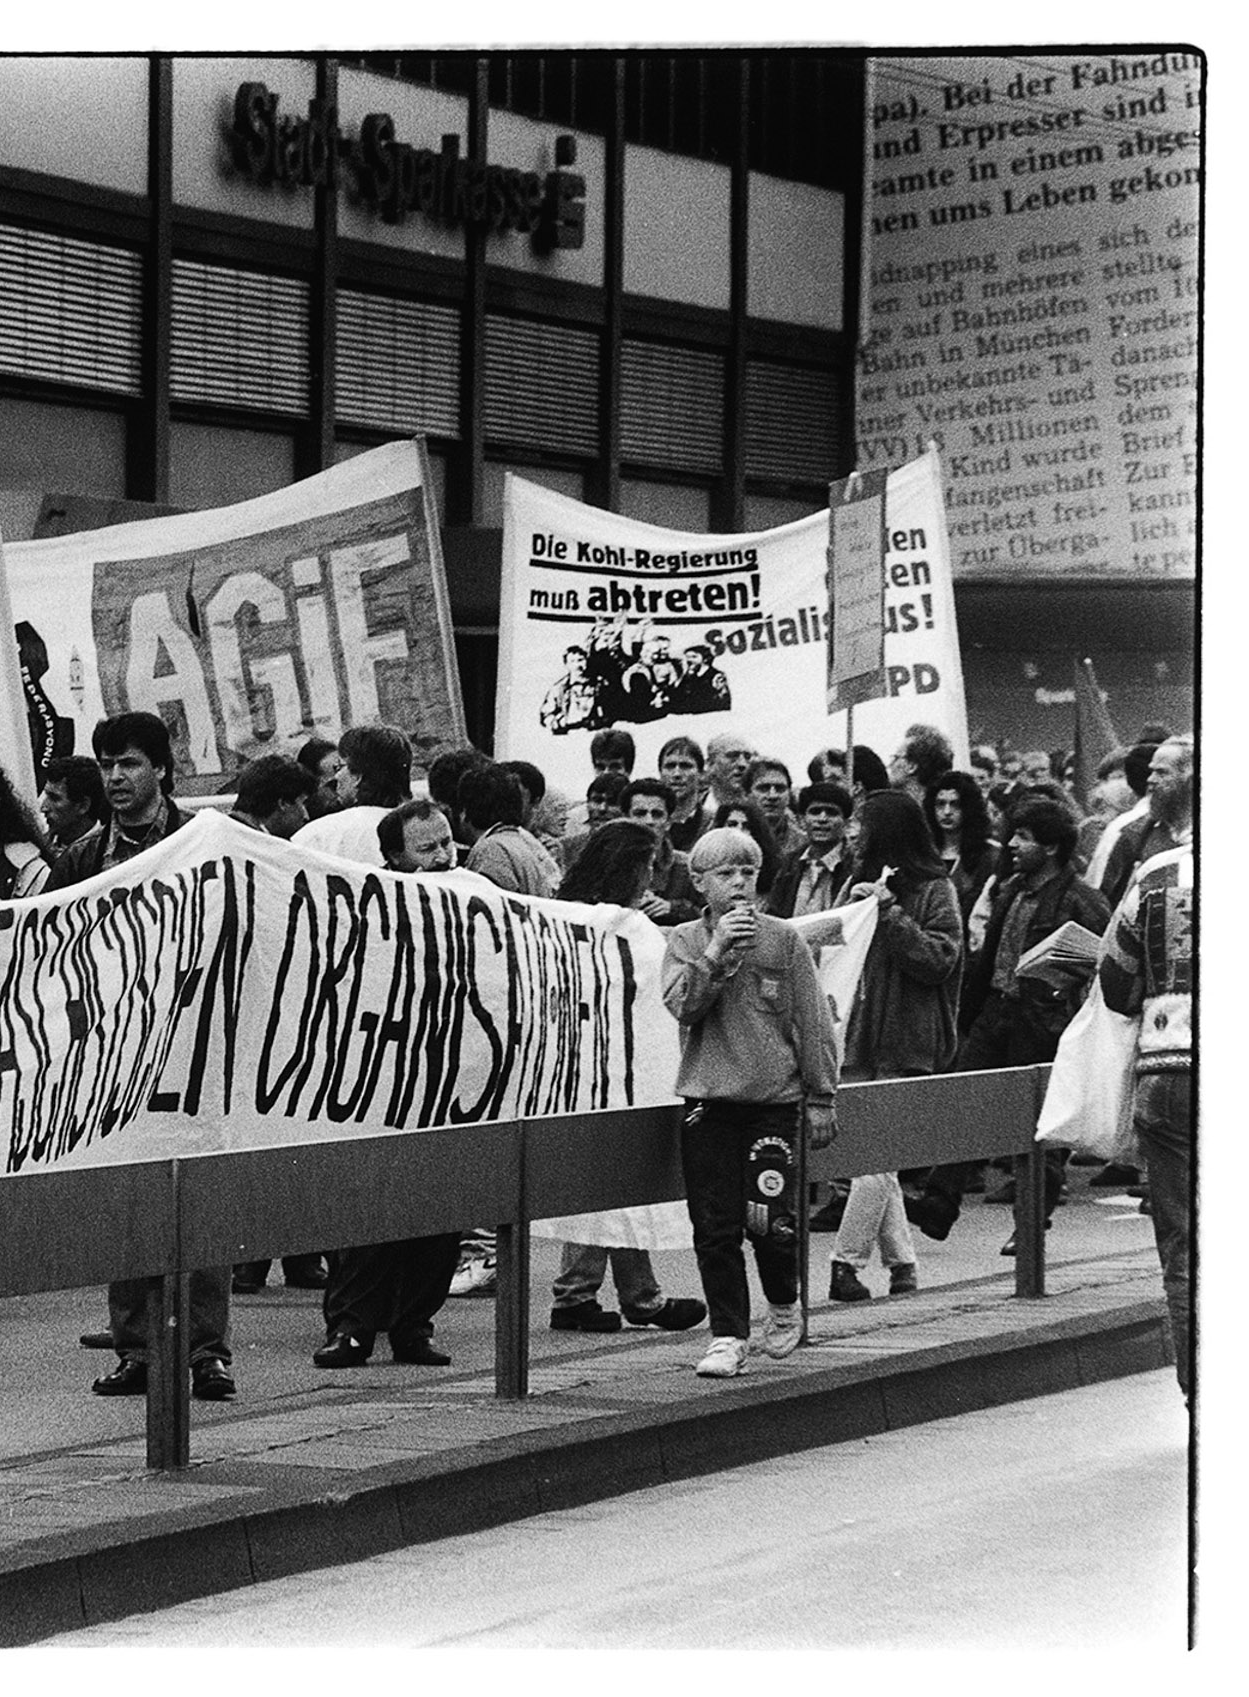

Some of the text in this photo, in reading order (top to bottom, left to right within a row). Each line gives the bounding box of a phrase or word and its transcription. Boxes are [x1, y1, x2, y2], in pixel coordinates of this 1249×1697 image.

[944, 77, 992, 110] Bei
[1007, 73, 1055, 99] der
[940, 109, 1086, 149] Erpresser
[1103, 88, 1166, 121] sind
[968, 156, 998, 182] in
[1011, 146, 1103, 175] einem
[1118, 130, 1199, 159] abge
[930, 203, 992, 226] ums
[1004, 183, 1096, 214] Leben
[1049, 378, 1096, 406] und
[951, 450, 1010, 478] Kind
[532, 533, 758, 572] Die Kohl-Regierung
[886, 527, 927, 552] en
[885, 560, 931, 588] en
[530, 574, 760, 612] muß abtreten!
